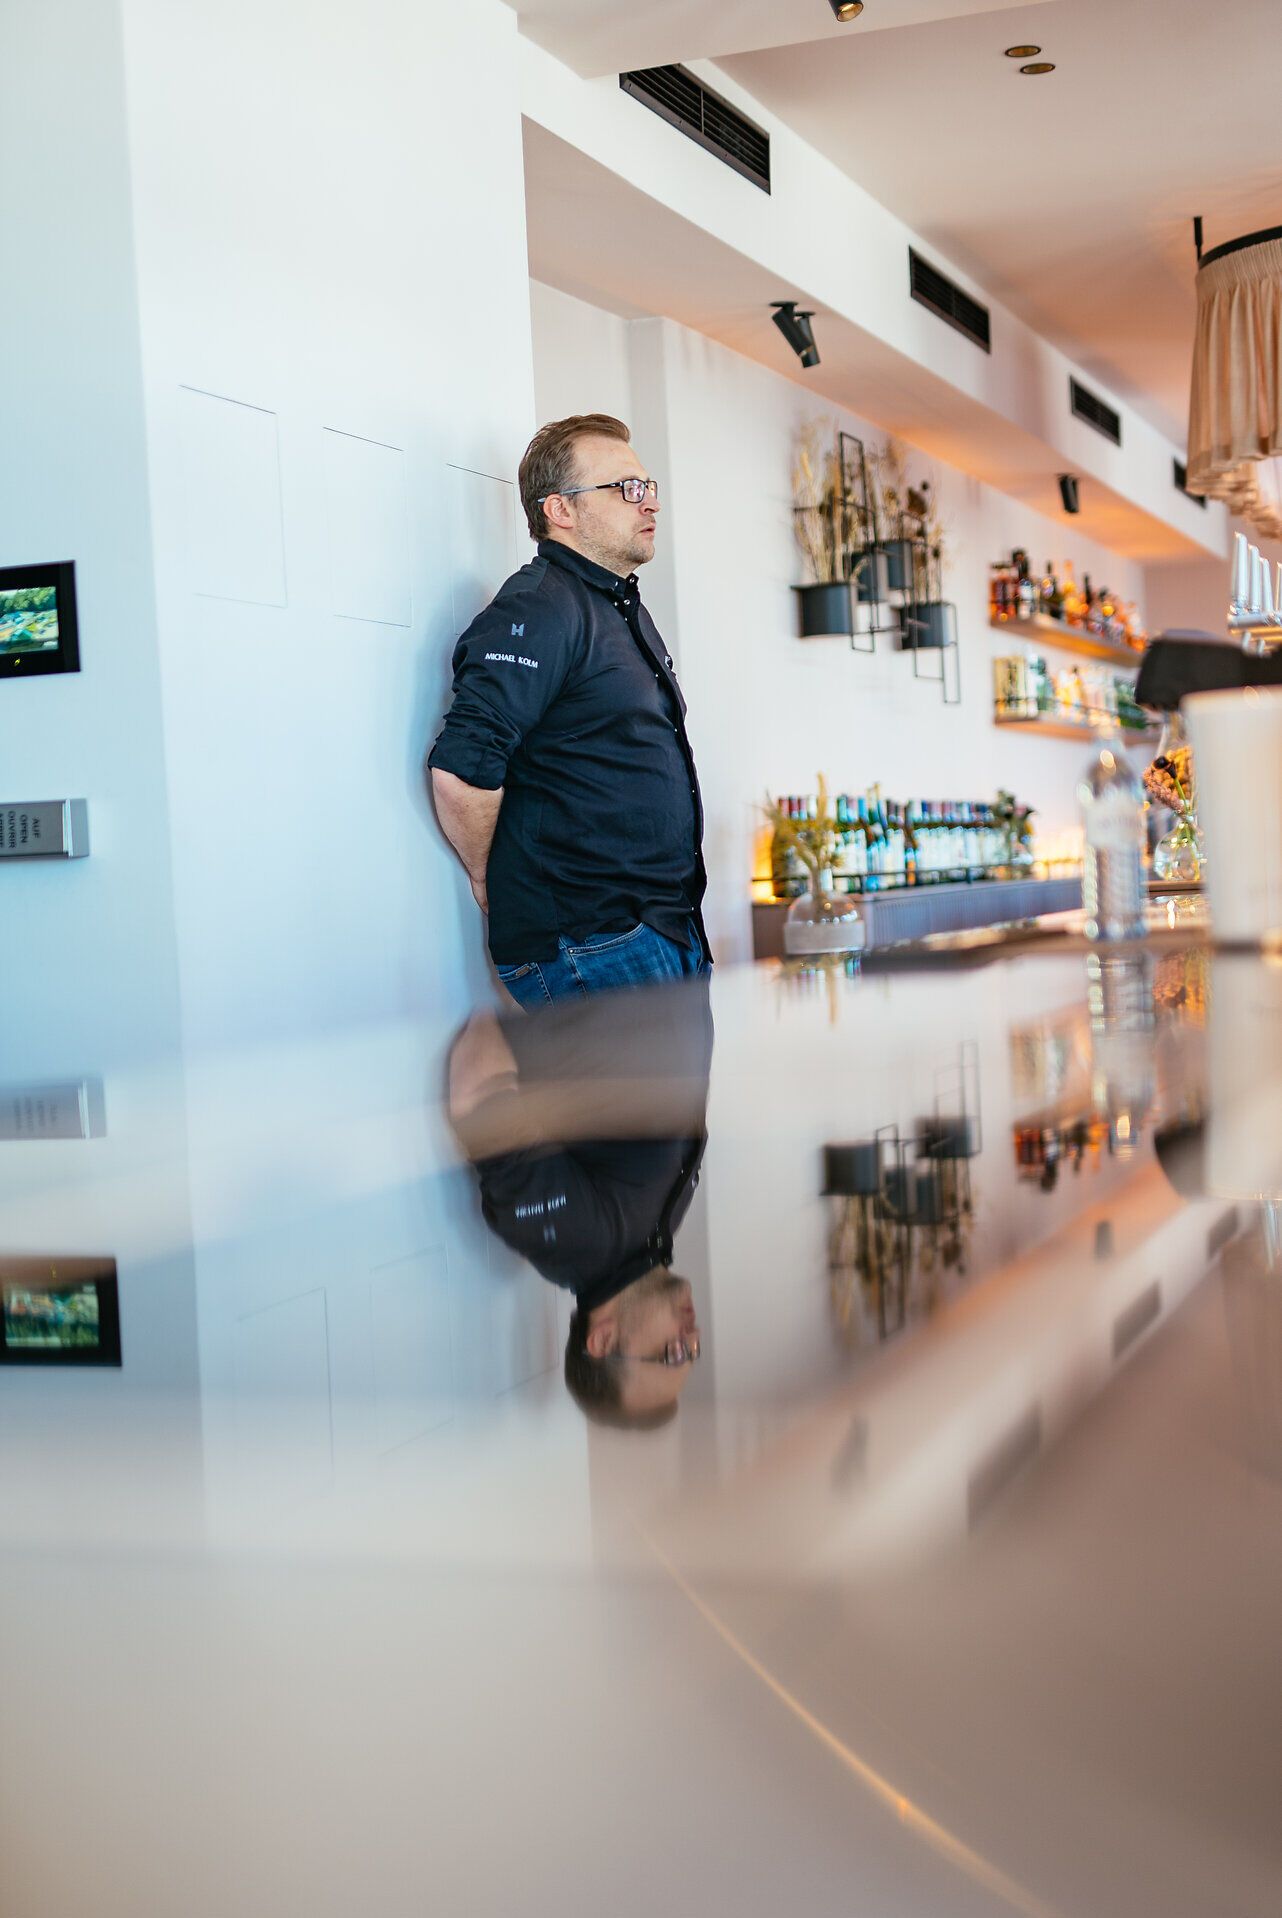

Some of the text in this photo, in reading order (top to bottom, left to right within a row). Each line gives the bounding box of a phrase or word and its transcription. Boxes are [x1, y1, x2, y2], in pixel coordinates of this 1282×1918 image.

[485, 652, 539, 669] MICHAEL KOLM
[8, 810, 17, 848] OUVRIR
[20, 814, 28, 843] OPEN
[32, 817, 40, 839] AUF
